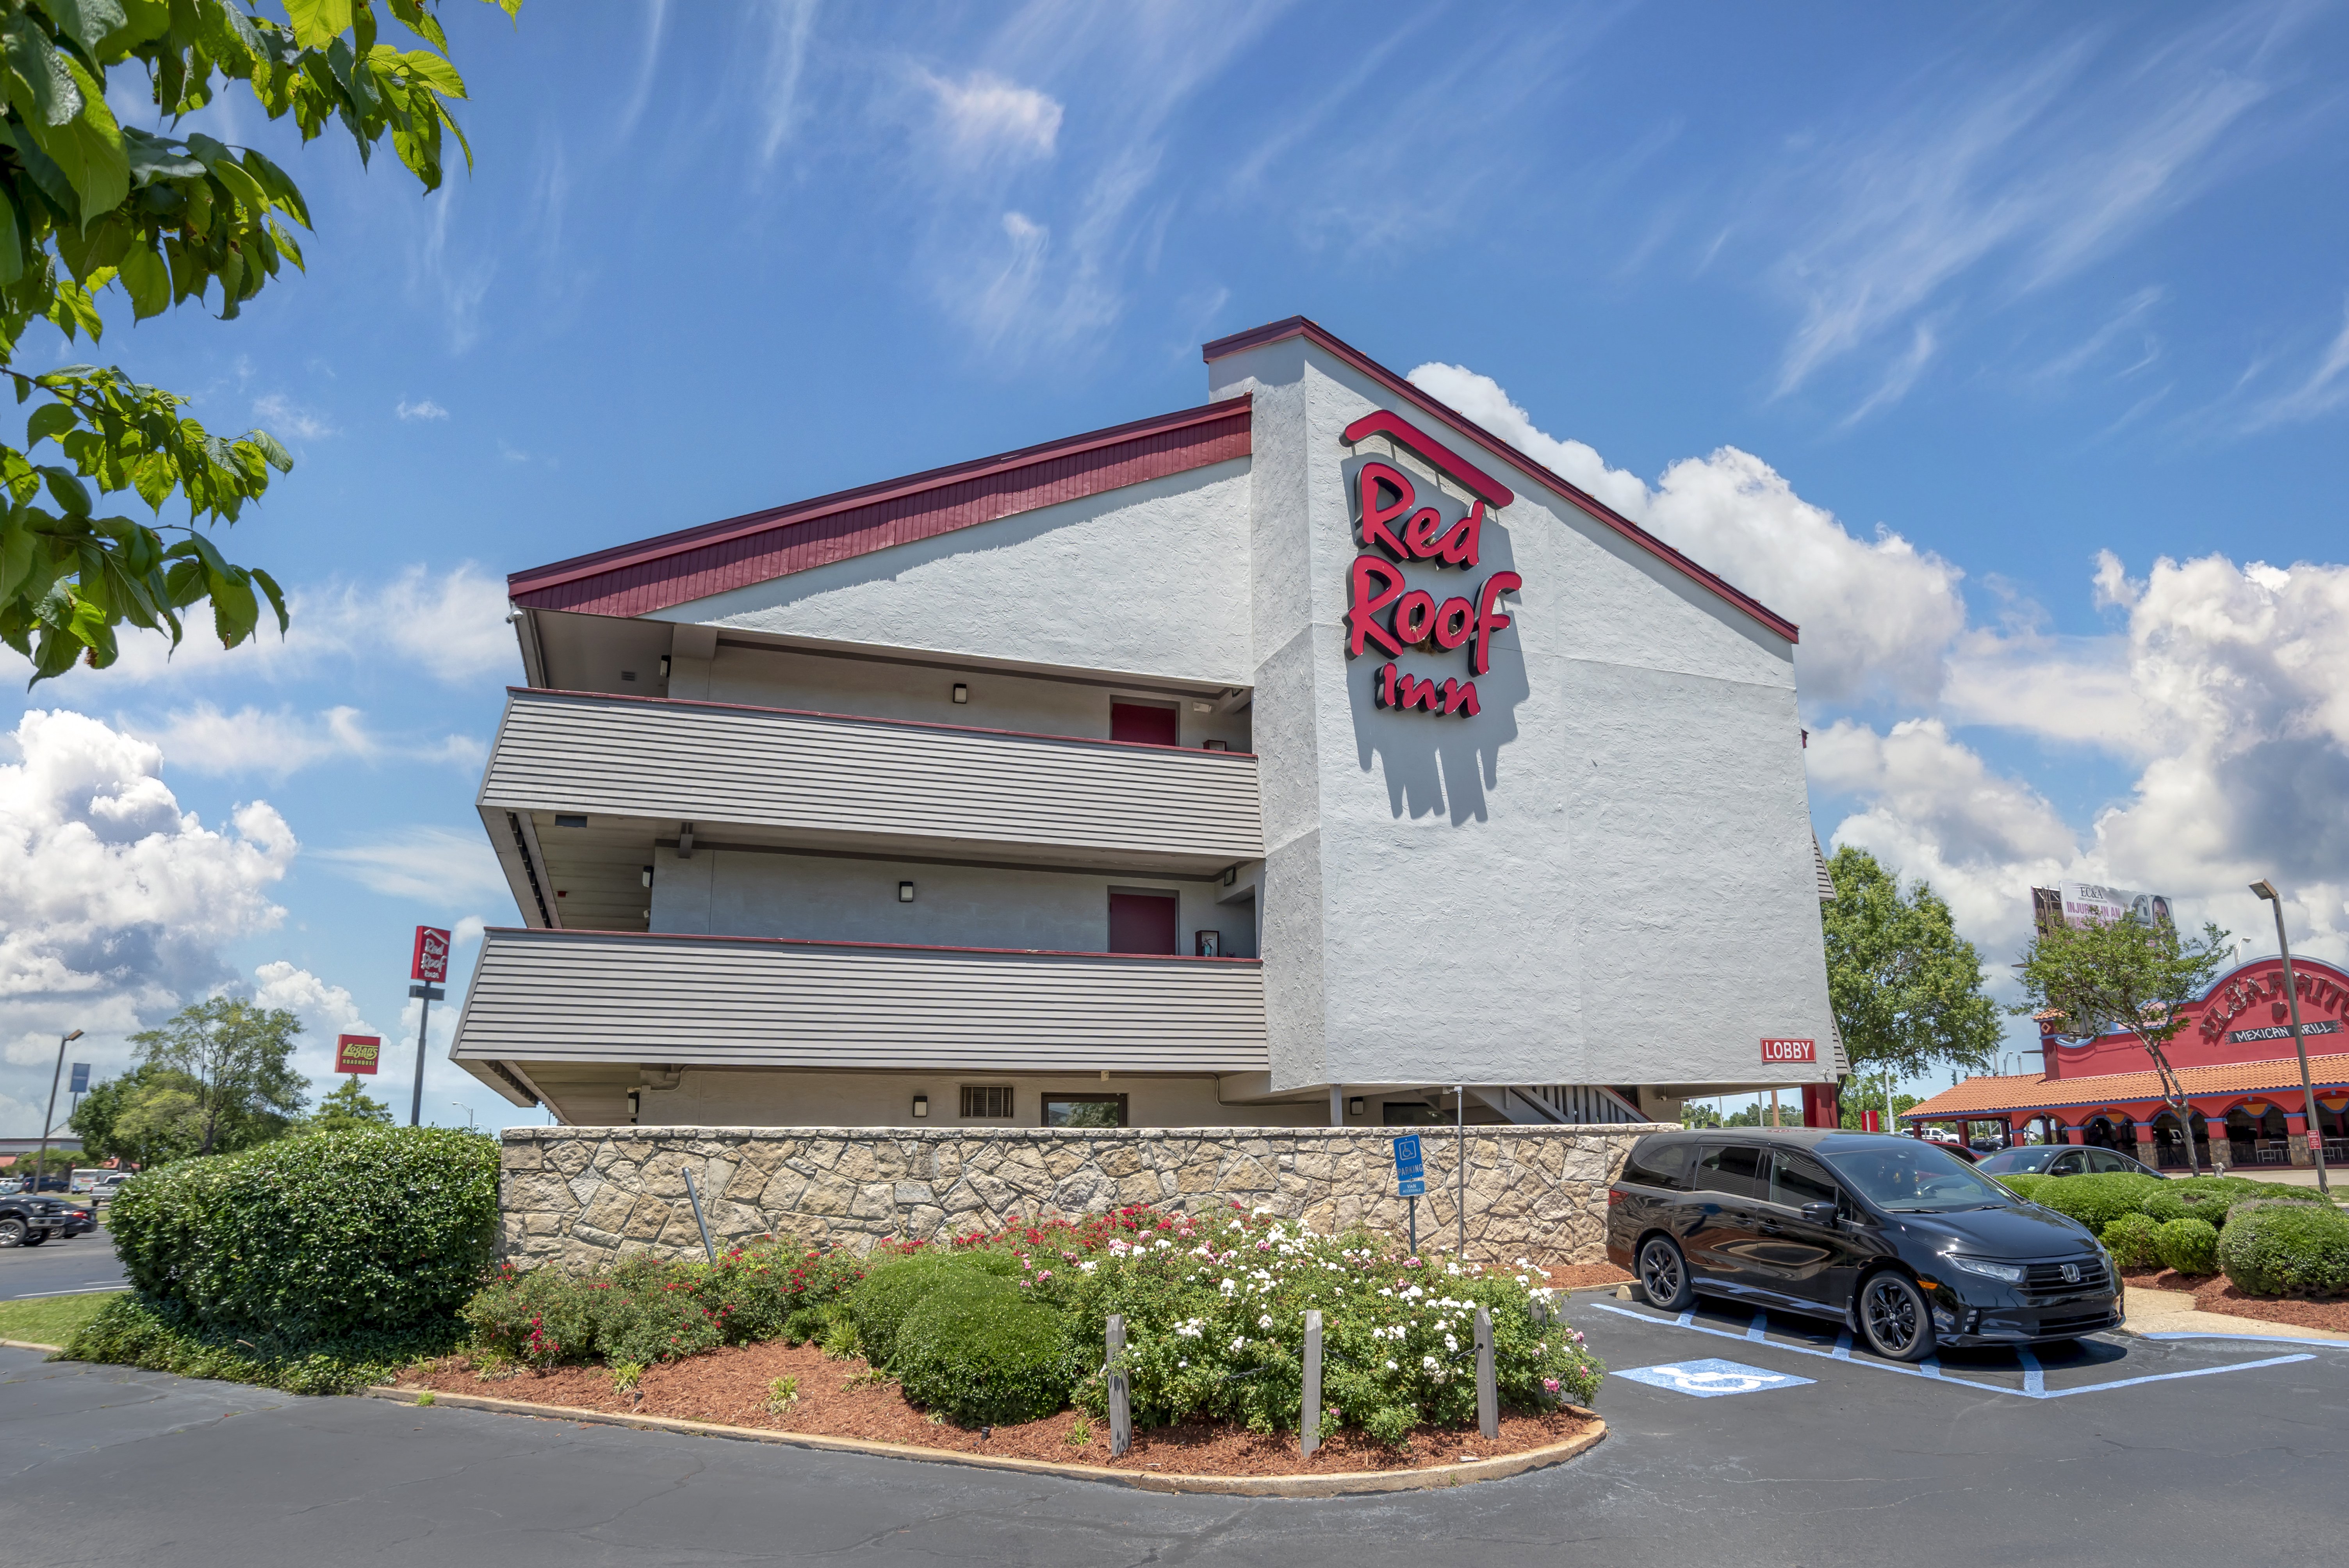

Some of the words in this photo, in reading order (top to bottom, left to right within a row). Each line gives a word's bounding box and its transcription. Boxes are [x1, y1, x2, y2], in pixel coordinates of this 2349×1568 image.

[1355, 462, 1484, 570] Red
[1342, 554, 1522, 677] Roof
[2080, 887, 2103, 899] EC&A
[2100, 905, 2109, 917] IN
[2111, 907, 2121, 918] AN
[424, 938, 444, 955] Red
[421, 953, 447, 972] Roof
[2200, 1006, 2234, 1039] EL
[2235, 1026, 2290, 1042] MEXICAN
[2301, 1022, 2332, 1036] RILL
[1765, 1042, 1810, 1059] LOBBY
[1397, 1164, 1423, 1176] PARKING
